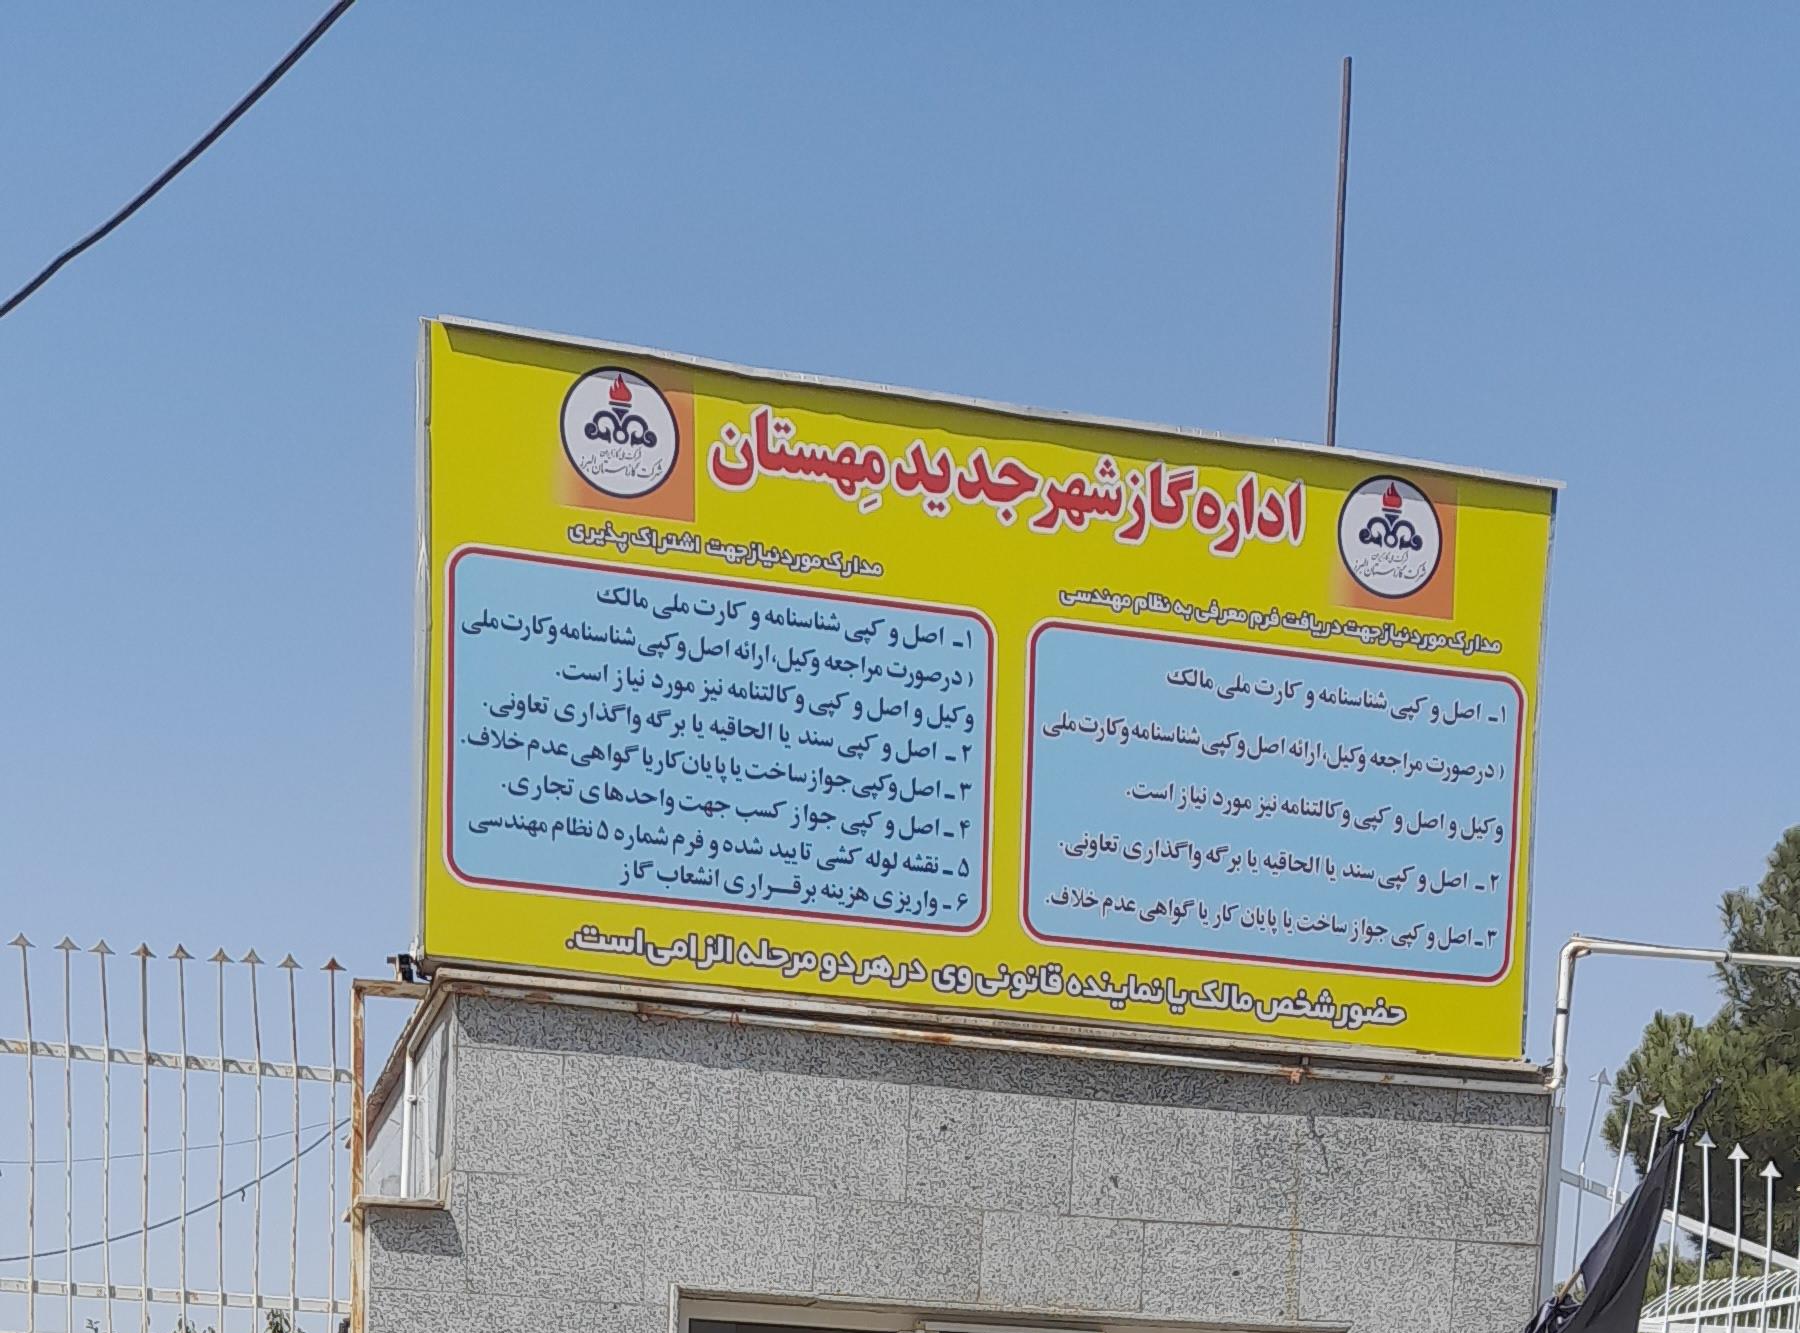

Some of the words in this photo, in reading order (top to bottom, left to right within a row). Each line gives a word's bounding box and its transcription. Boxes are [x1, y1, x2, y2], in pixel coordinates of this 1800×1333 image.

[892, 445, 1039, 522] جدید
[1032, 457, 1124, 532] شهر
[1118, 464, 1195, 543] گاز
[1193, 477, 1303, 555] اداره
[596, 586, 649, 610] مالک
[652, 592, 690, 620] ملی
[461, 608, 499, 635] ملی
[693, 599, 747, 627] کارت
[764, 607, 841, 633] شناسنامه
[559, 620, 637, 647] شناسنامه
[844, 618, 886, 645] کپی
[902, 623, 945, 650] اصل
[687, 635, 731, 663] اصل
[733, 640, 771, 671] ارائه
[611, 666, 646, 693] نیاز
[823, 654, 883, 684] مراجعه
[1166, 668, 1214, 690] مالک
[651, 672, 696, 701] مورد
[698, 678, 724, 703] نیز
[1216, 674, 1251, 700] ملی
[1254, 679, 1303, 706] کارت
[1318, 687, 1388, 710] شناسنامه
[553, 701, 642, 735] واگذاری
[808, 691, 851, 718] کپی
[866, 696, 909, 723] اصل
[1390, 696, 1429, 721] کپی
[1442, 700, 1482, 726] اصل
[645, 708, 686, 739] برگه
[692, 713, 705, 740] یا
[708, 715, 773, 742] الحاقیه
[926, 703, 975, 734] وکیل
[1042, 711, 1077, 738] ملی
[778, 723, 792, 750] یا
[797, 729, 834, 748] سند
[837, 733, 879, 761] کپی
[1131, 722, 1201, 746] شناسنامه
[527, 738, 569, 762] عدم
[570, 742, 640, 772] گواهی
[642, 746, 654, 773] یا
[894, 737, 938, 765] اصل
[1246, 735, 1286, 761] اصل
[1288, 739, 1322, 767] ارائه
[652, 749, 686, 776] کار
[681, 753, 728, 784] پایان
[730, 756, 743, 783] یا
[744, 761, 808, 784] ساخت
[1369, 752, 1423, 778] مراجعه
[806, 766, 853, 795] جواز
[899, 776, 941, 804] اصل
[678, 795, 732, 819] جهت
[1176, 785, 1207, 810] نیاز
[1212, 791, 1252, 817] مورد
[1254, 795, 1277, 819] نیز
[734, 800, 788, 824] کسب
[789, 803, 837, 832] جواز
[840, 810, 883, 838] کپی
[1353, 806, 1392, 832] کپی
[1406, 810, 1445, 836] اصل
[468, 814, 548, 838] مهندسی
[551, 816, 594, 842] نظام
[613, 823, 669, 851] شماره
[898, 815, 941, 842] اصل
[1460, 816, 1504, 844] وکیل
[672, 829, 704, 857] فرم
[722, 836, 764, 856] شده
[769, 841, 813, 866] تایید
[1122, 839, 1202, 870] واگذاری
[816, 844, 863, 872] کشی
[865, 849, 899, 878] لوله
[901, 853, 939, 875] نقشه
[1205, 845, 1242, 874] برگه
[1247, 849, 1258, 874] یا
[1263, 851, 1321, 876] الحاقیه
[1325, 857, 1336, 882] یا
[1342, 863, 1375, 880] سند
[618, 859, 654, 887] گاز
[656, 864, 720, 890] انشعاب
[1377, 865, 1416, 891] کپی
[1429, 869, 1468, 895] اصل
[820, 883, 870, 909] هزینه
[872, 889, 938, 917] واریزی
[1102, 896, 1136, 918] عدم
[1139, 898, 1195, 926] گواهی
[1198, 901, 1209, 926] یا
[1211, 903, 1240, 929] کار
[1240, 907, 1278, 935] پایان
[1283, 910, 1293, 934] یا
[1296, 914, 1348, 934] ساخت
[1349, 918, 1389, 945] جواز
[1390, 923, 1426, 948] کپی
[1437, 926, 1473, 951] اصل
